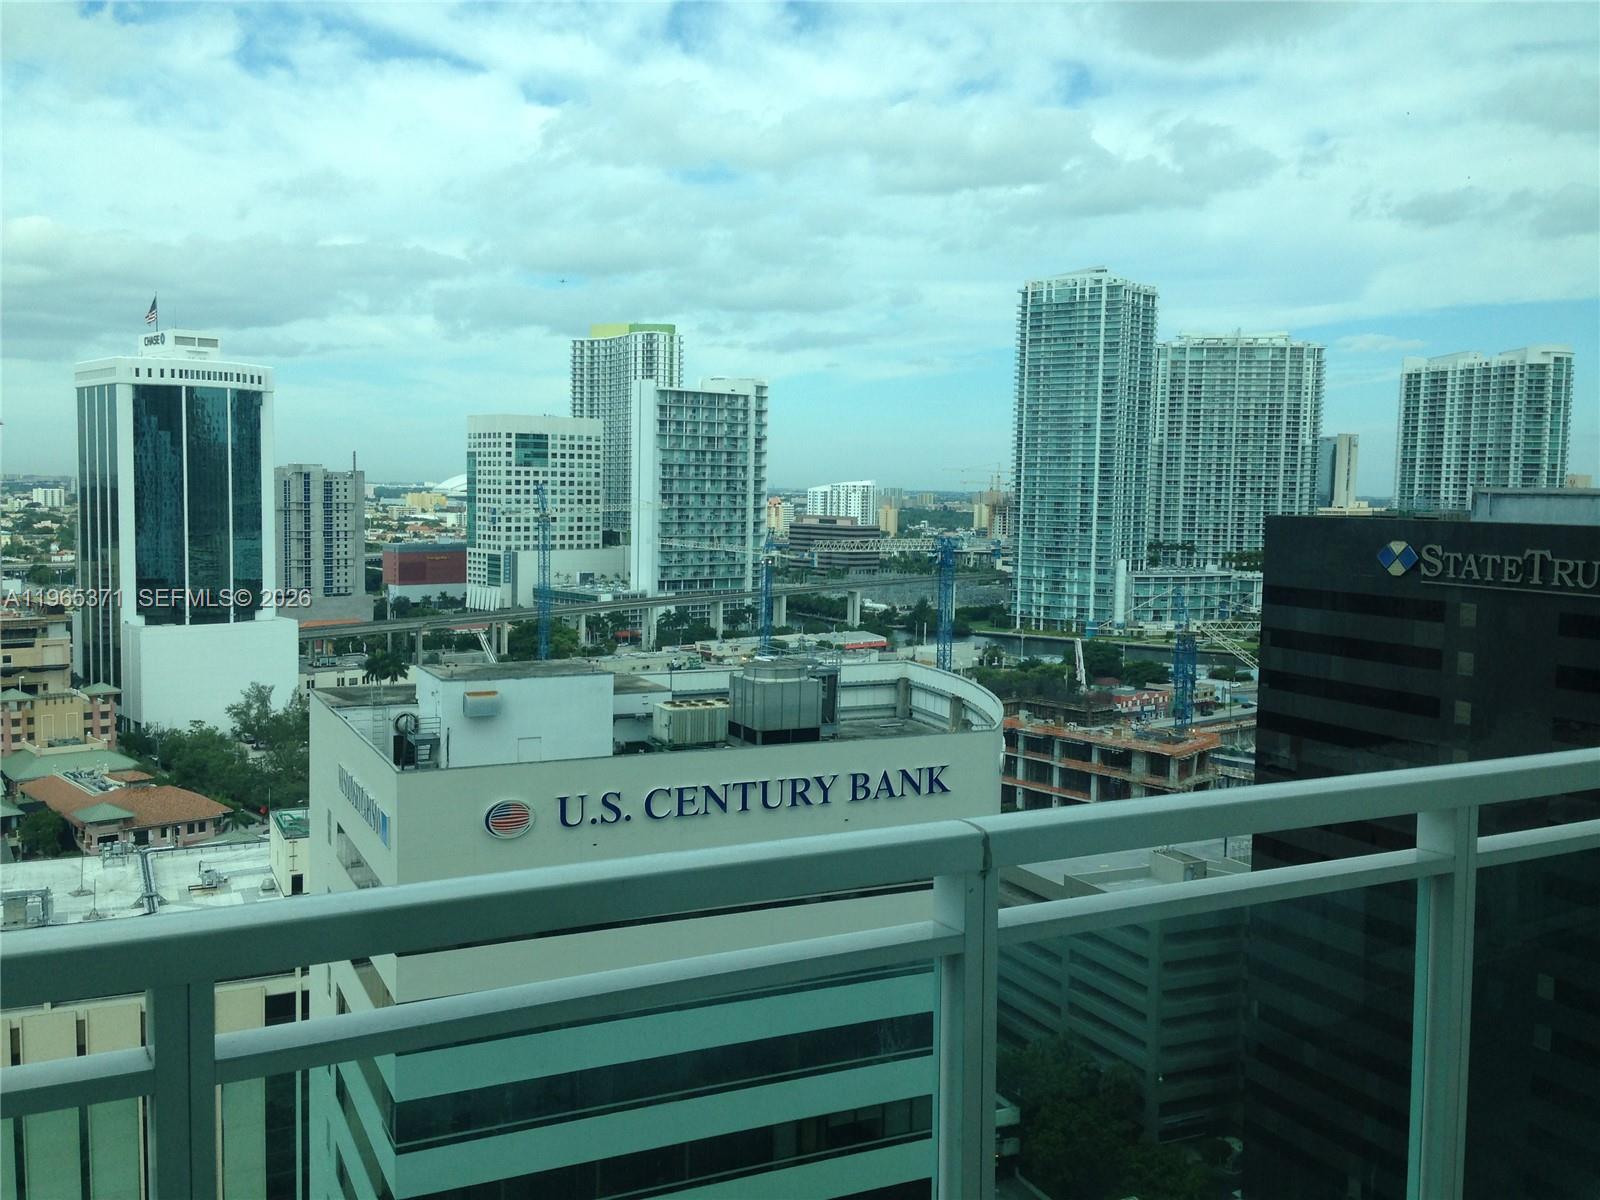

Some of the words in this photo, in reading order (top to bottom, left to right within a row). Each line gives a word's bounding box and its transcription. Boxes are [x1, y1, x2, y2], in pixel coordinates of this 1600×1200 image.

[144, 335, 160, 346] CHASE
[556, 791, 632, 828] U.S.
[644, 774, 840, 820] CENTURY
[849, 764, 951, 802] BANK
